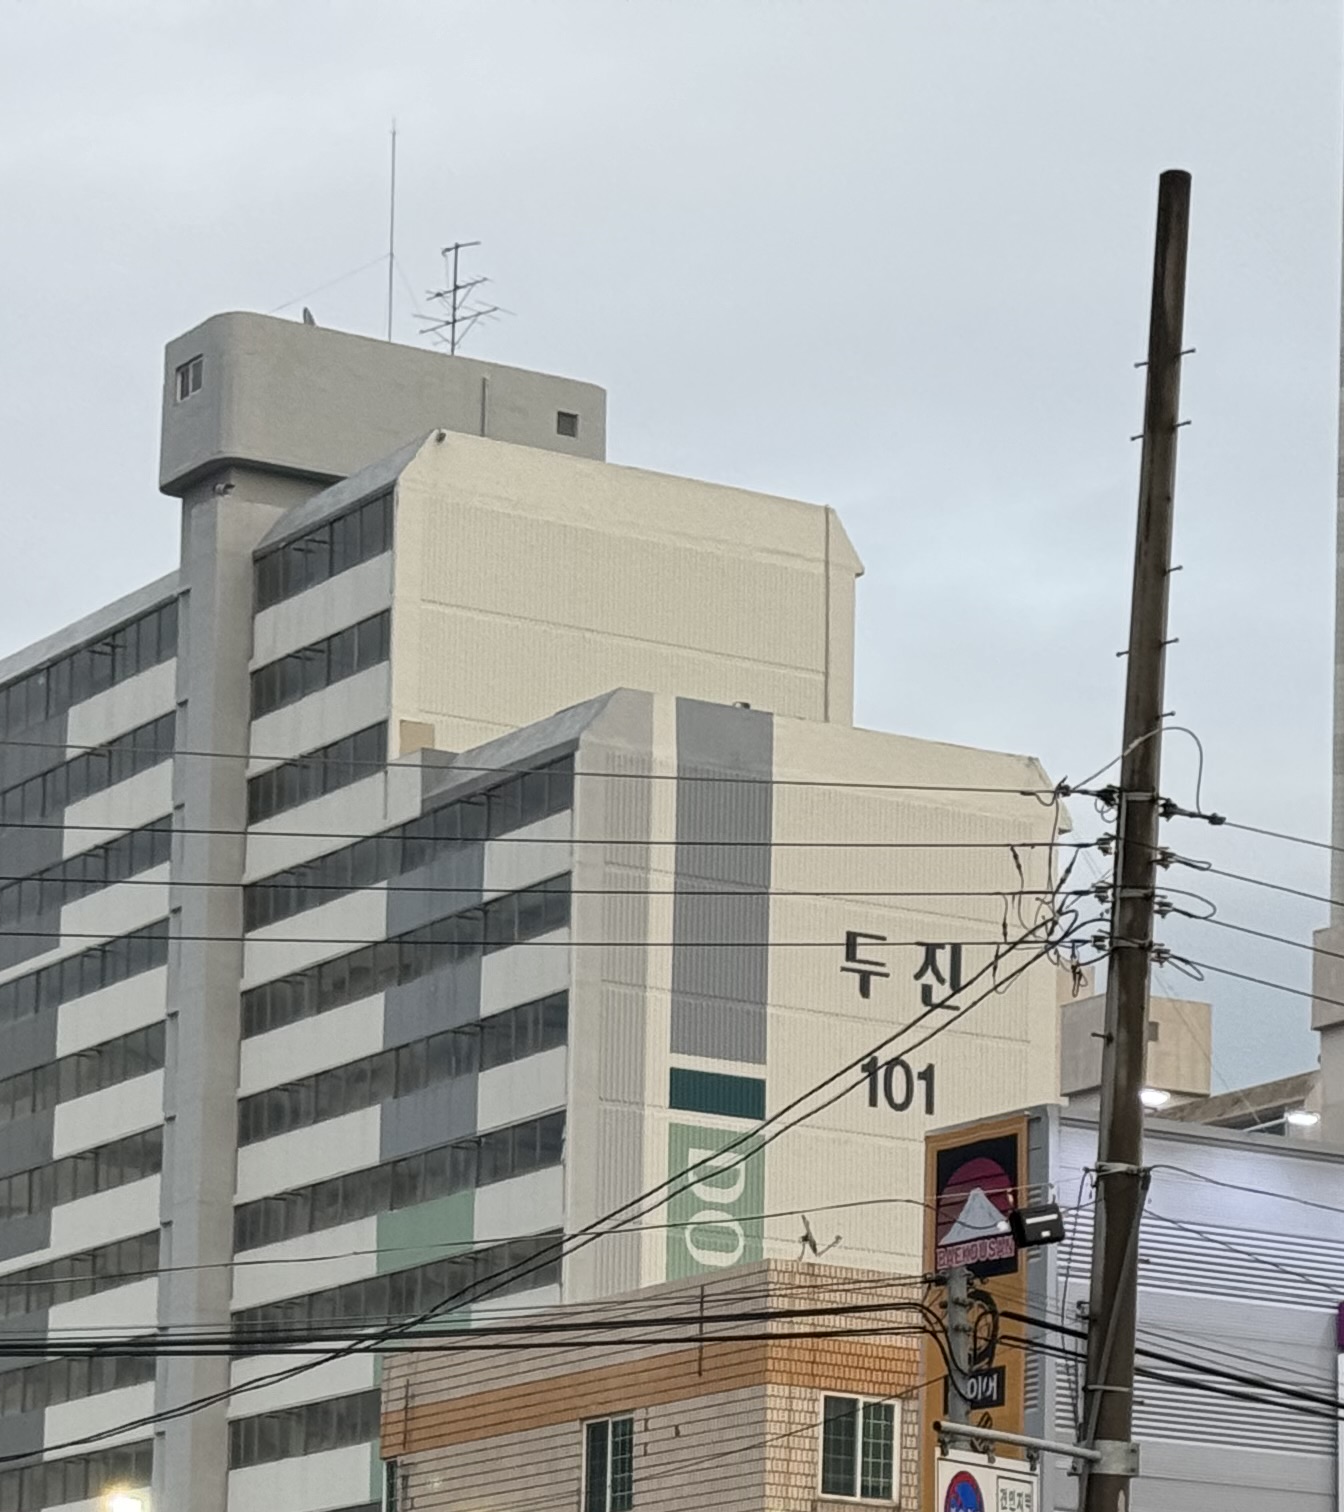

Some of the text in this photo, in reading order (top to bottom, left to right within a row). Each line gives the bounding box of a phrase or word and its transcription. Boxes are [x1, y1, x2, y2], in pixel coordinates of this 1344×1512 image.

[861, 1055, 936, 1116] 101
[936, 1235, 1016, 1269] BAEKDUSAN
[967, 1373, 999, 1401] 이어
